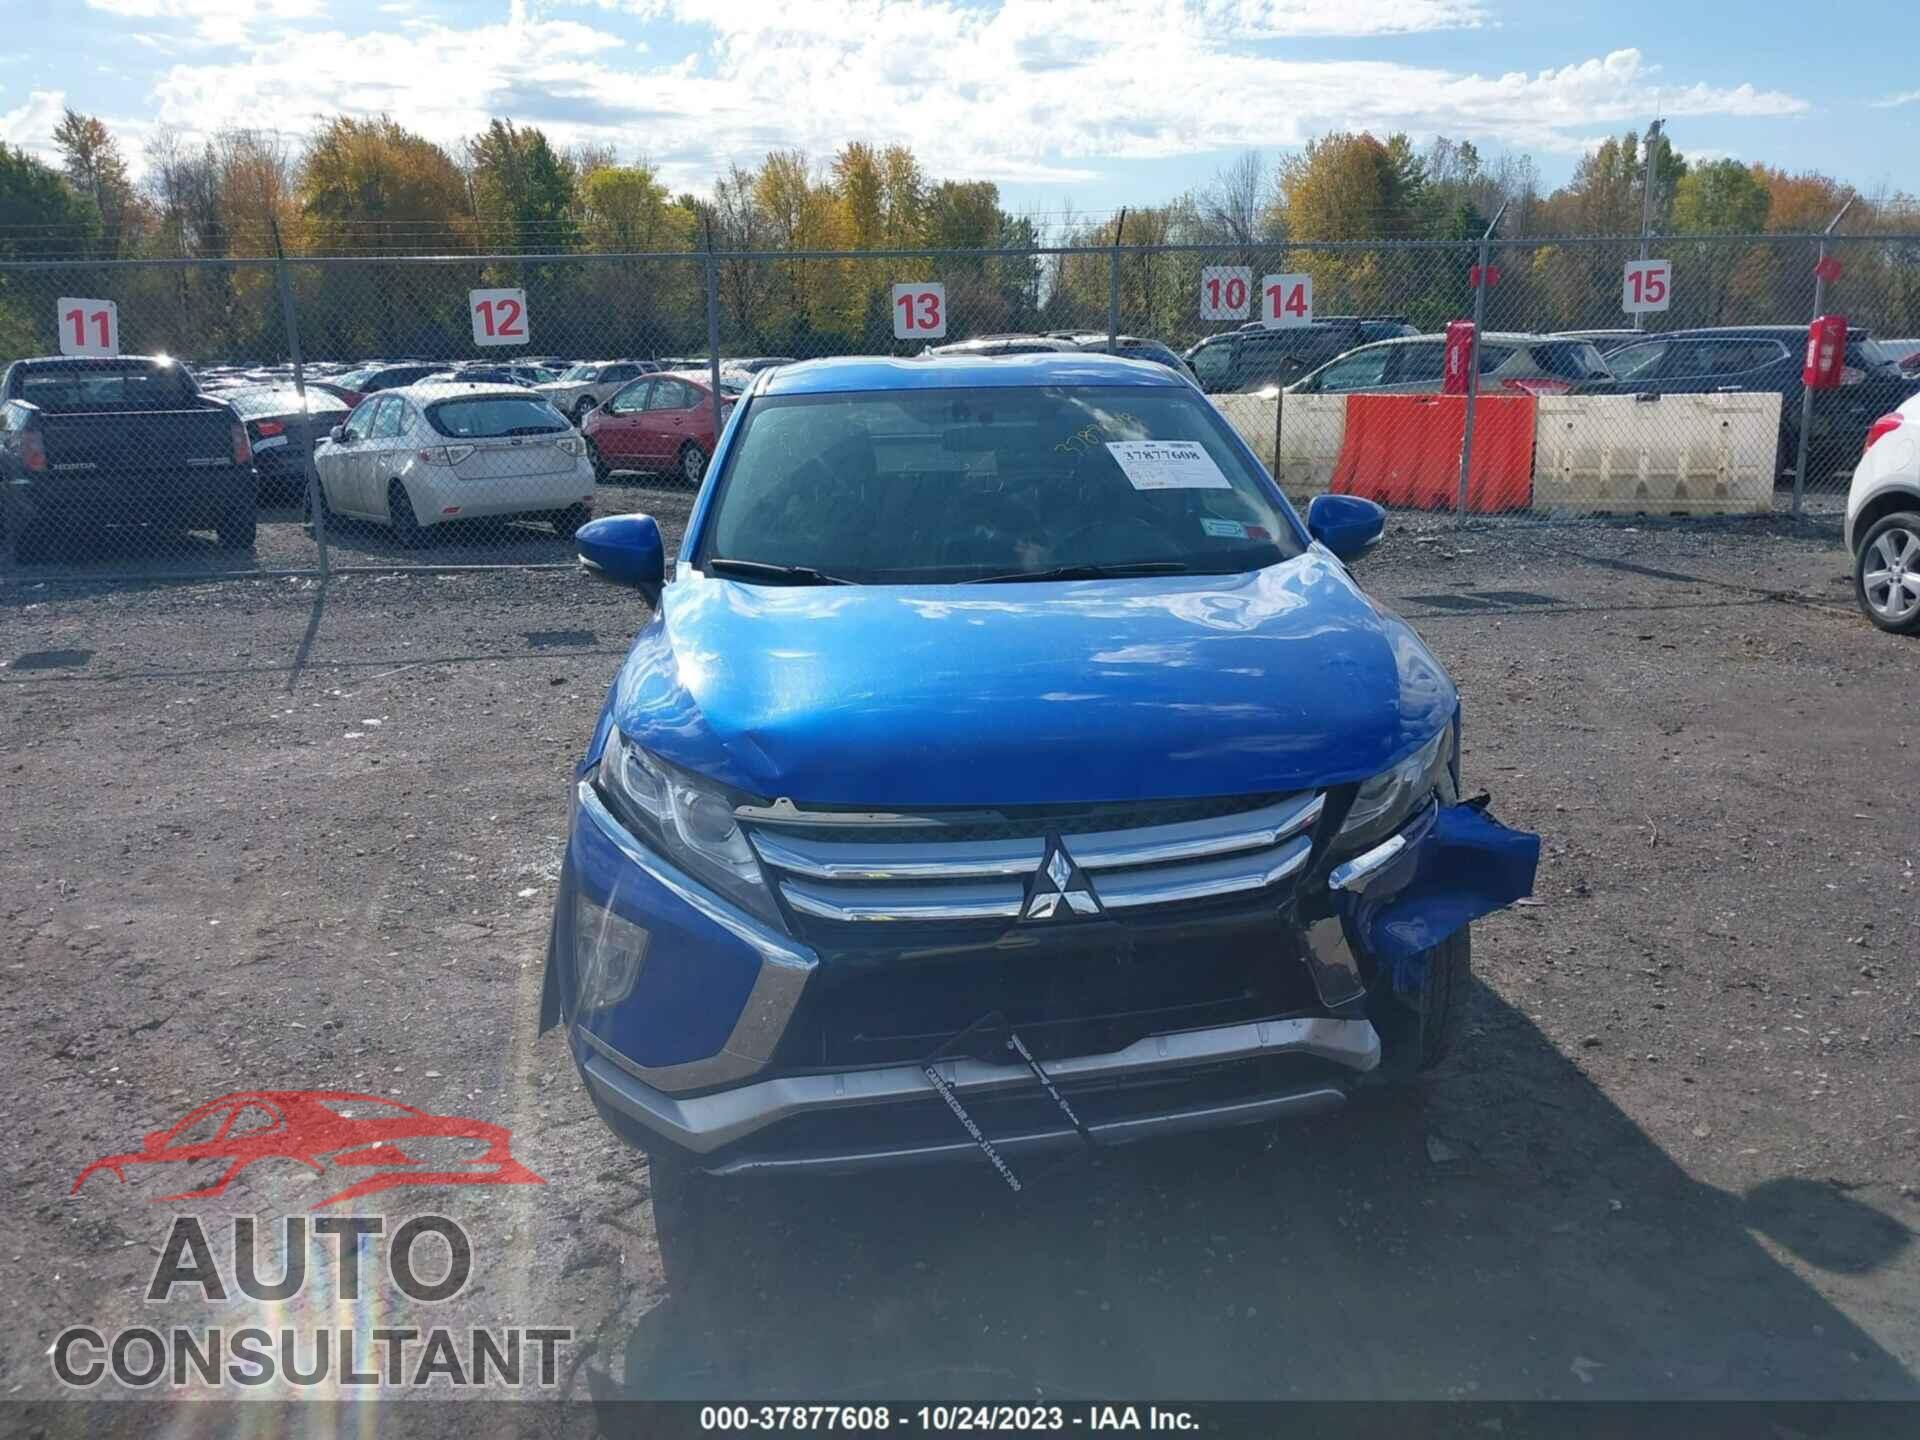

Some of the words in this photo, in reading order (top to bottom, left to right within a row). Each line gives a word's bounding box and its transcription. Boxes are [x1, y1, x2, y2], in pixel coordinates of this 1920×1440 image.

[1206, 278, 1246, 310] 10
[1266, 284, 1308, 318] 14
[1627, 270, 1667, 304] 15
[475, 299, 524, 337] 12
[897, 292, 941, 330] 13
[66, 309, 110, 348] 11
[1123, 450, 1201, 461] 37877608
